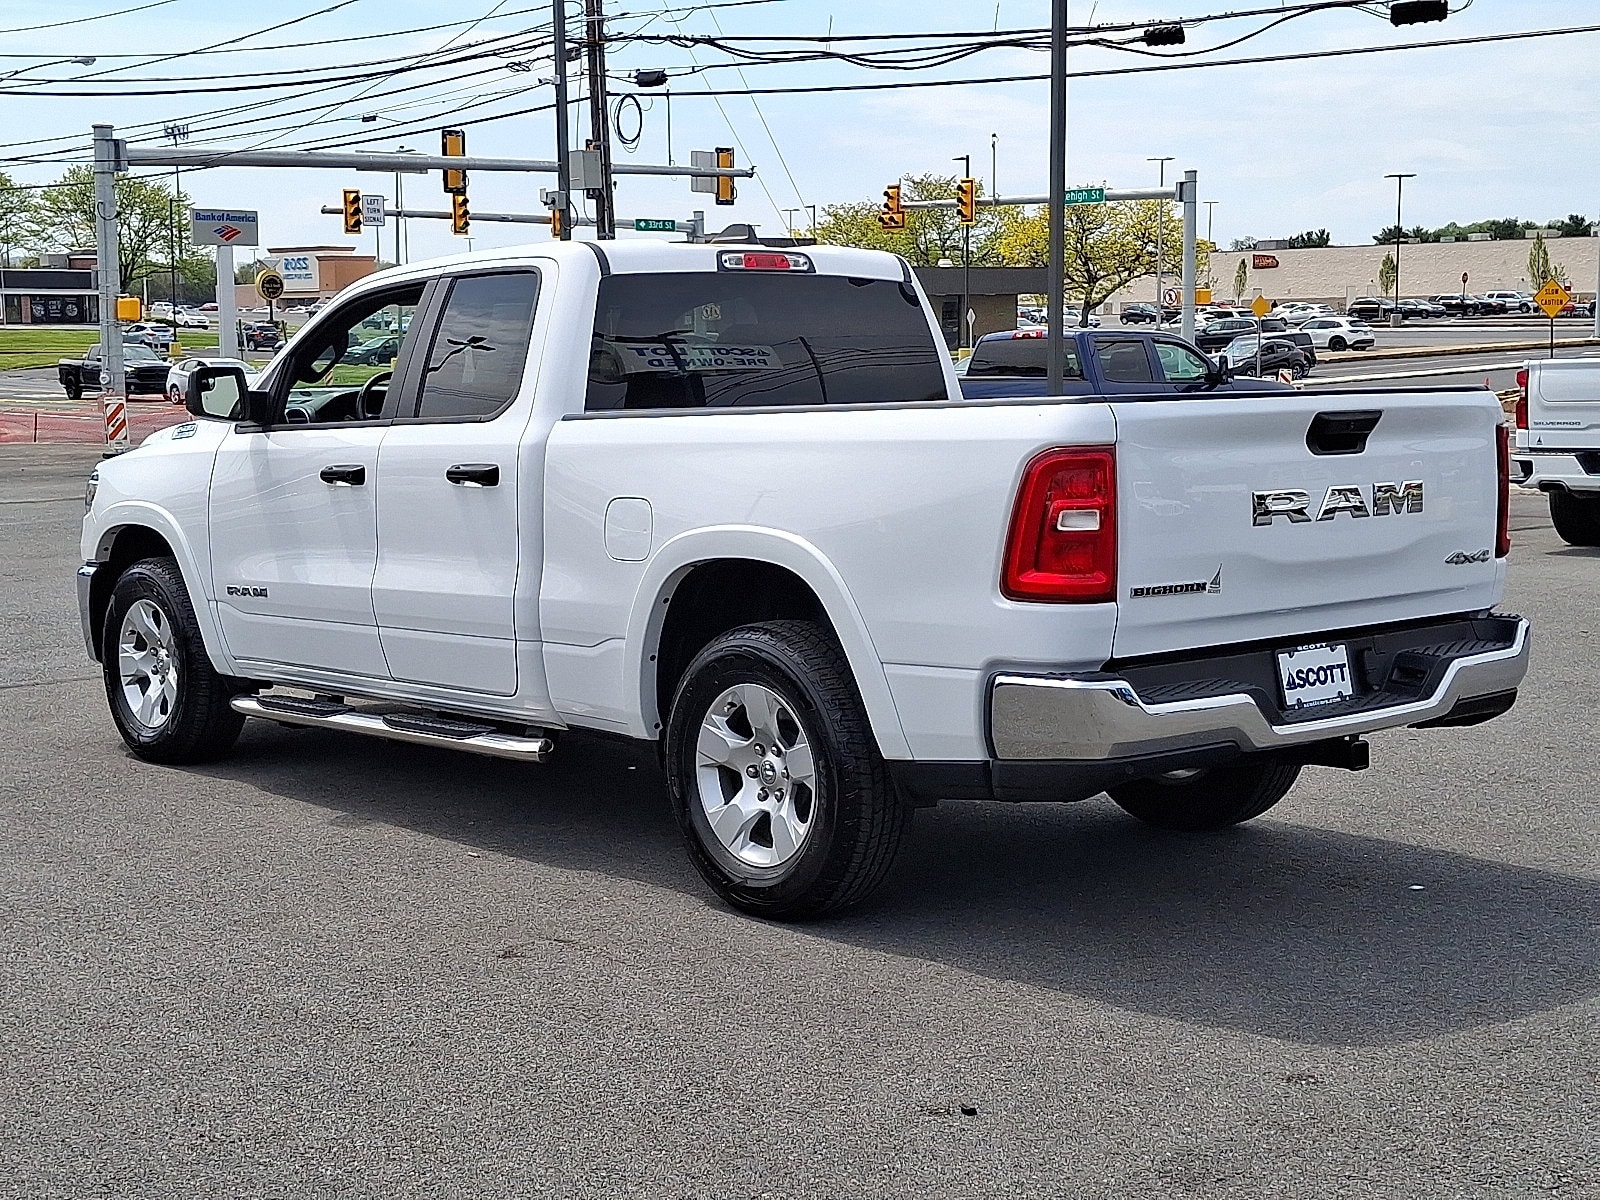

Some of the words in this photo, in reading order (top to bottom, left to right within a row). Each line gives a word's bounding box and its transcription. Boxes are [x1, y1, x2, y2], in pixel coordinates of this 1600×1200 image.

[1065, 191, 1088, 203] ehigh
[1091, 190, 1100, 200] St
[195, 212, 216, 221] Bank
[216, 213, 225, 221] of
[225, 213, 256, 222] America
[648, 221, 663, 229] 33rd
[283, 257, 309, 271] ROSS
[1541, 298, 1564, 306] CAUTION
[1251, 479, 1425, 527] RAM
[226, 584, 268, 598] RAM
[1129, 581, 1208, 599] BIGHORN
[1296, 643, 1327, 651] SCOTT
